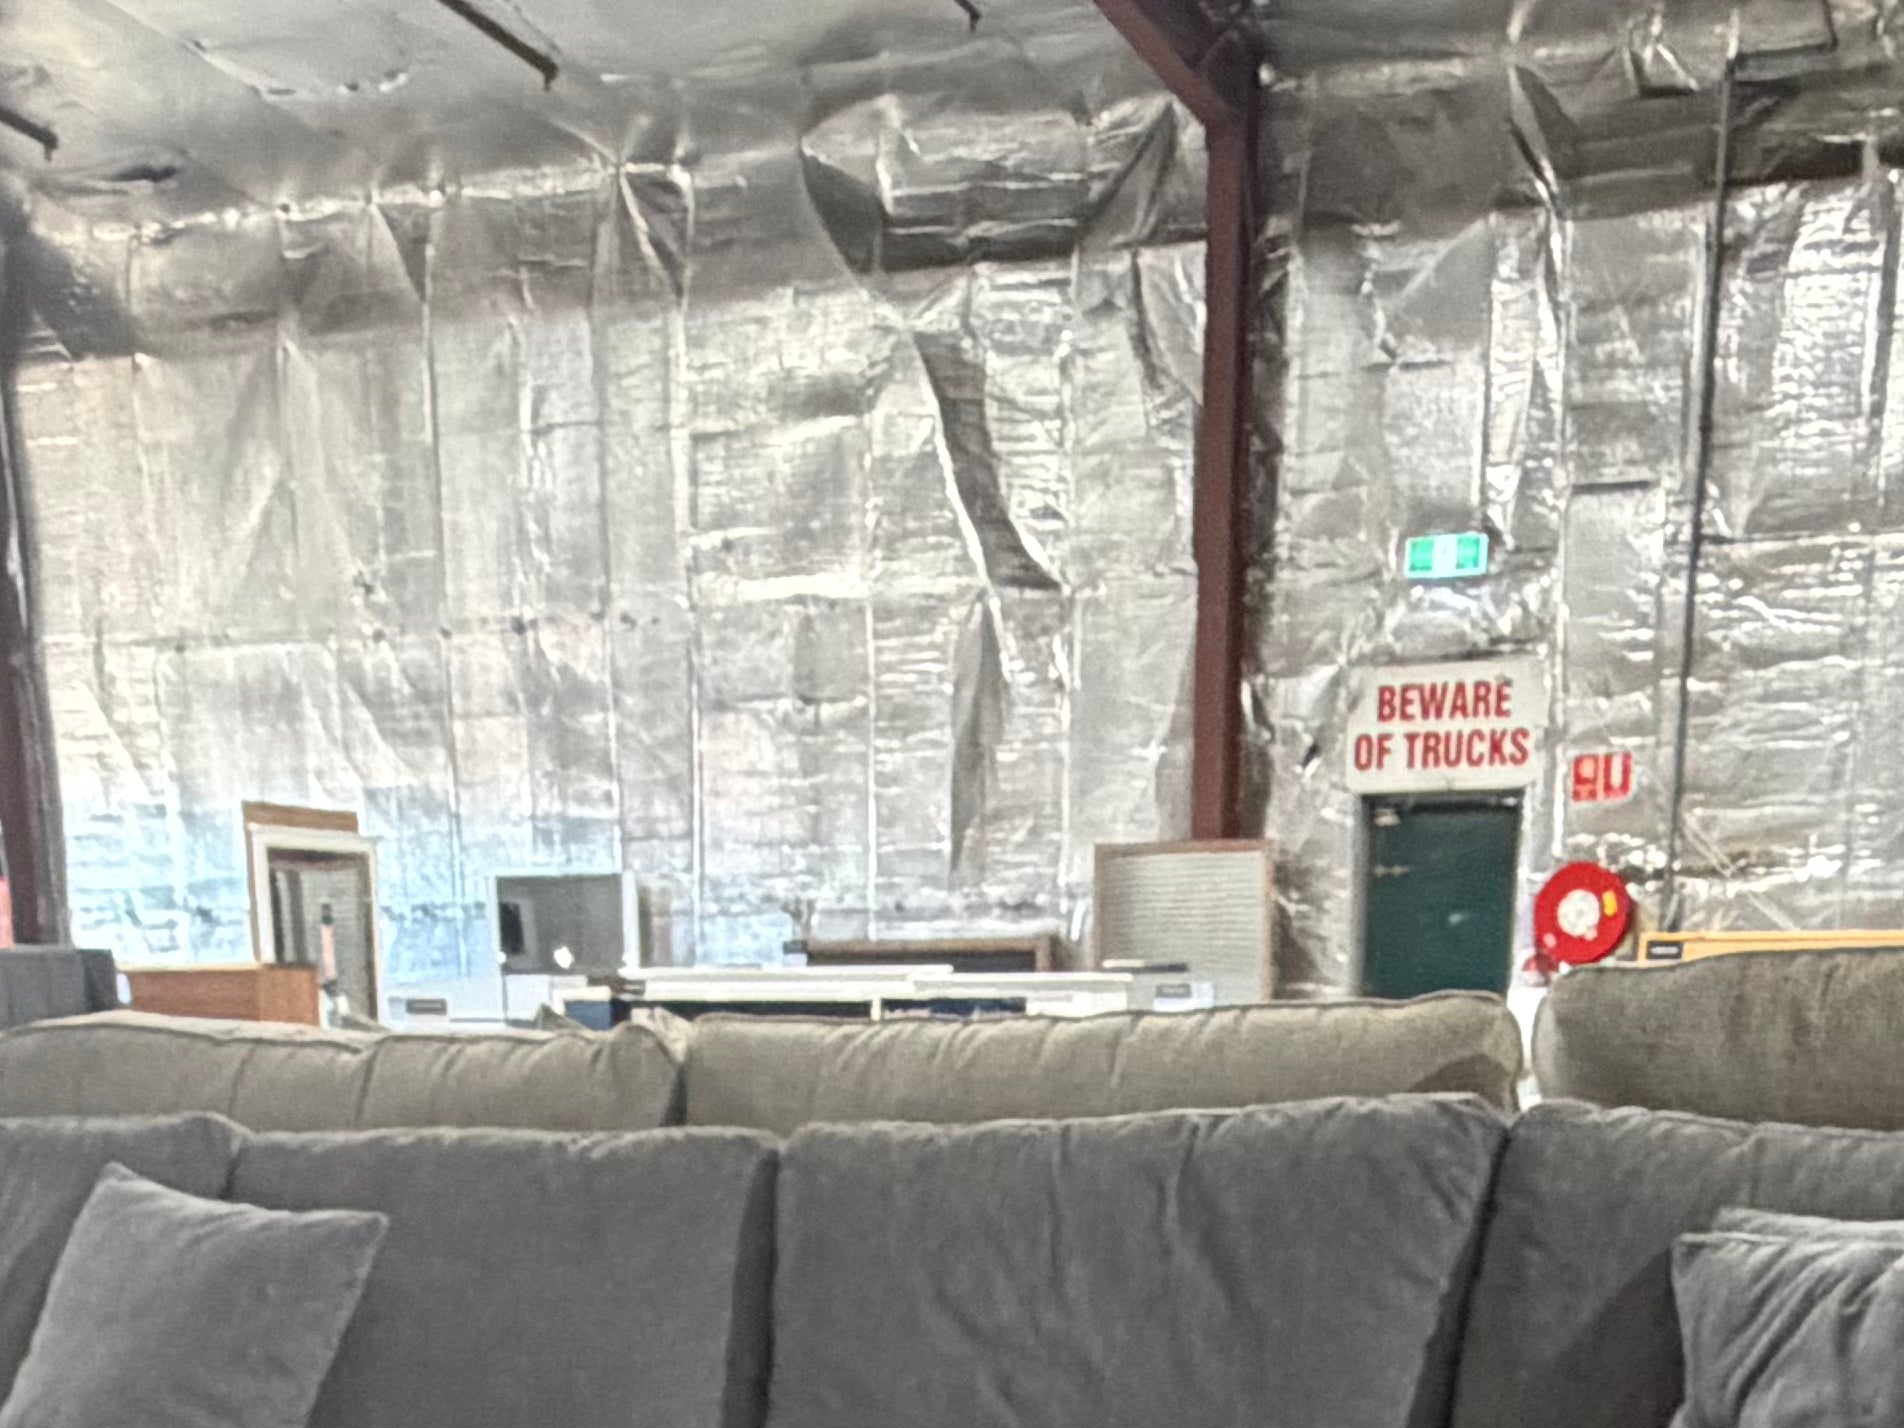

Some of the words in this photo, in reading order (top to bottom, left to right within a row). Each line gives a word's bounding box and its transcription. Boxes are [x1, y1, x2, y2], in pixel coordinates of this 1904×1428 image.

[1377, 680, 1513, 723] BEWARE
[1354, 733, 1393, 771] OF
[1405, 727, 1530, 769] TRUCKS
